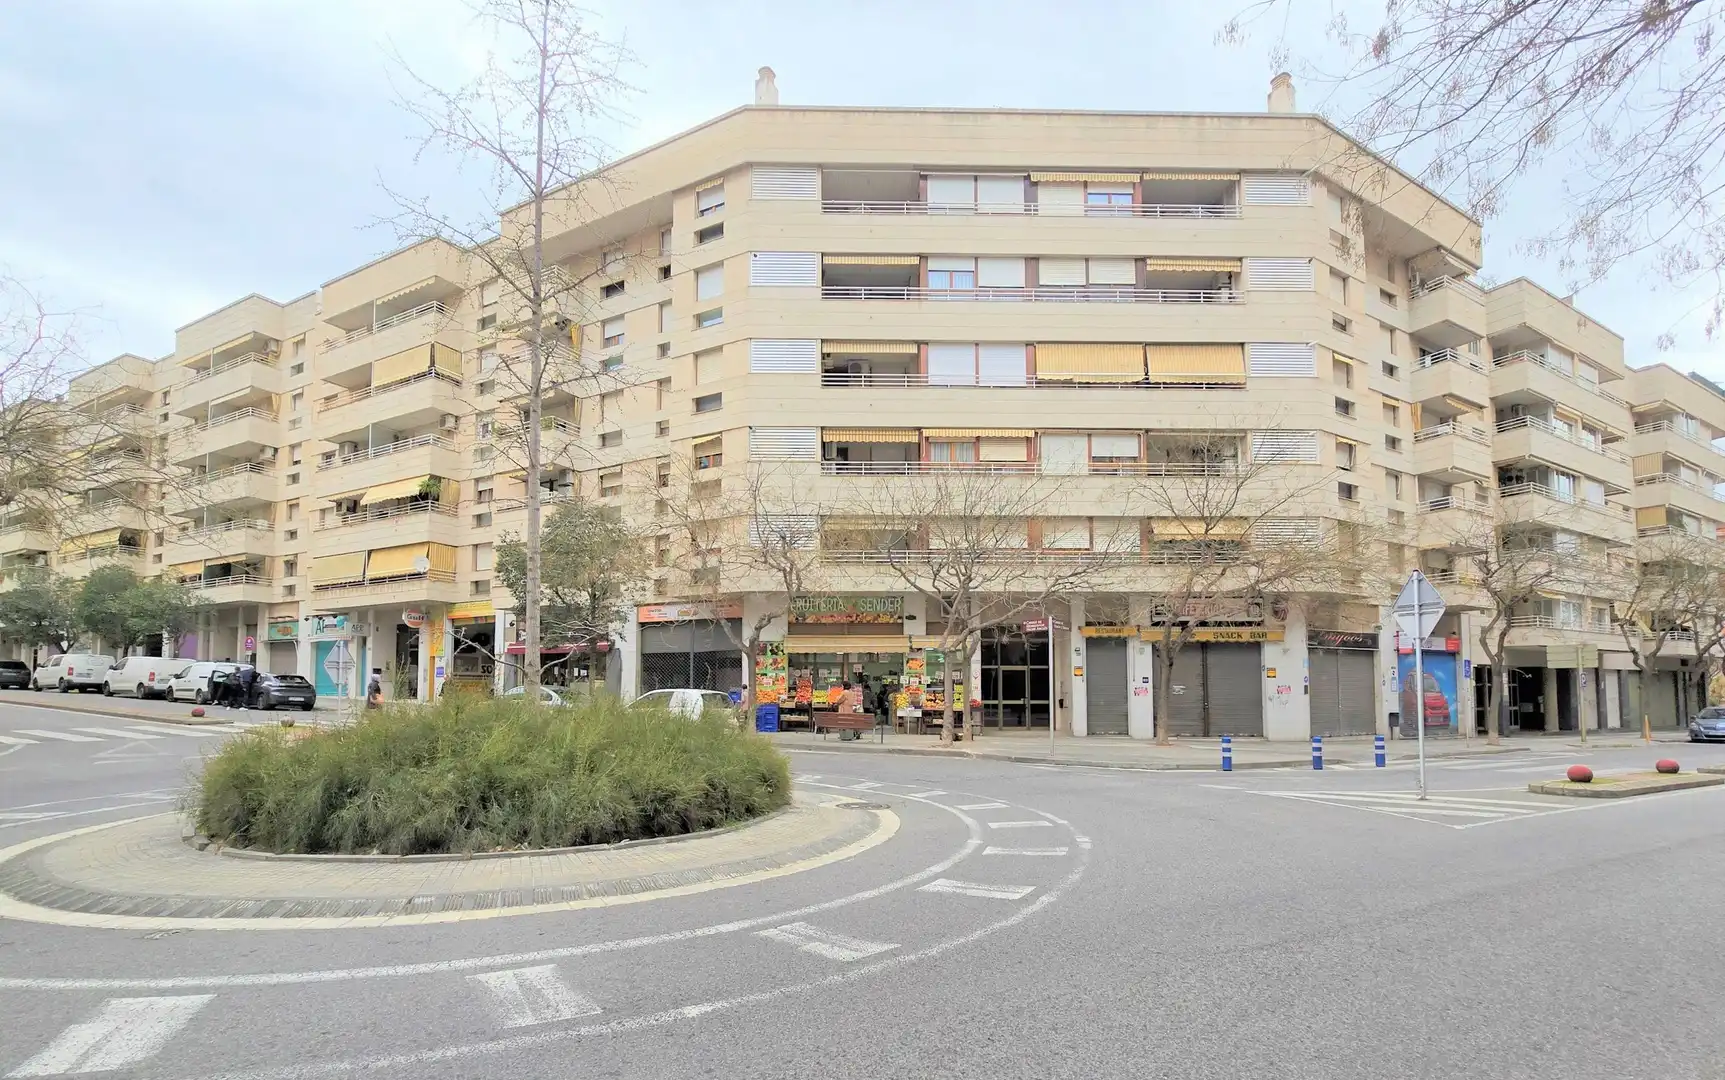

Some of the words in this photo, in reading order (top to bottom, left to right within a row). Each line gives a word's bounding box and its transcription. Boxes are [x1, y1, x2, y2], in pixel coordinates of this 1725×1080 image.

[860, 597, 901, 612] SENDER
[1213, 632, 1243, 640] SNACK
[1250, 632, 1268, 640] BAR
